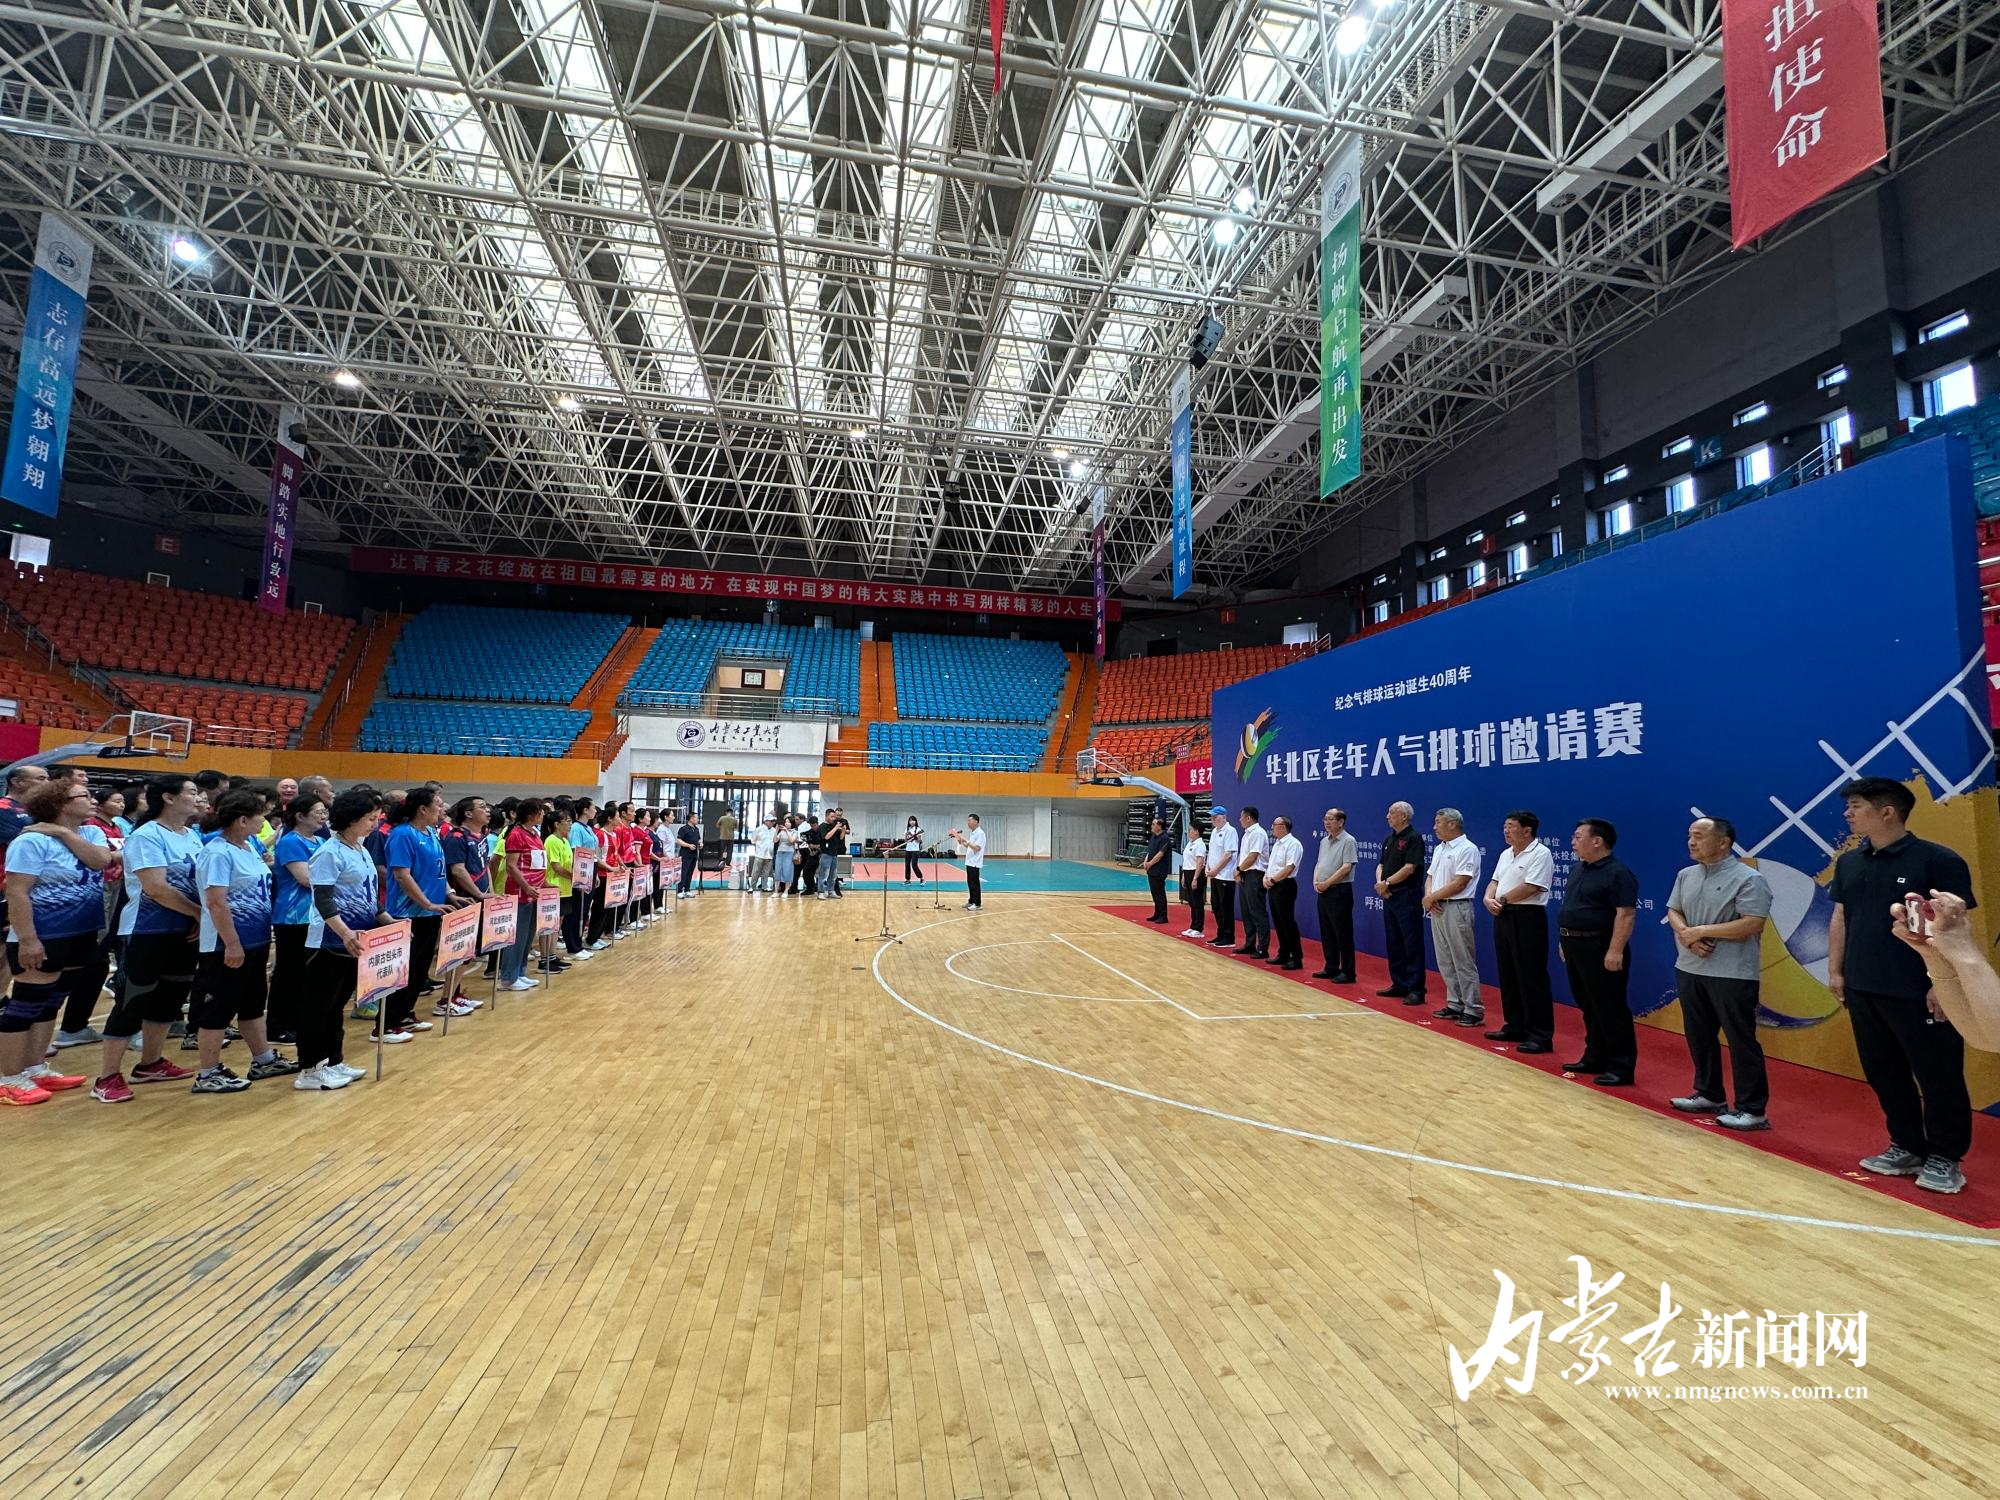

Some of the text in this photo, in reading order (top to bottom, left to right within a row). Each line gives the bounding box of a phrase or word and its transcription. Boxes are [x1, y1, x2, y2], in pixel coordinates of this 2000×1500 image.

[1330, 243, 1349, 466] 扬帆启航再出发
[22, 301, 69, 491] 志存高远梦翱翔
[266, 462, 294, 598] 脚踏实地行致远
[390, 553, 1093, 617] 让青春之花绽放在祖国最需要的地方 在实现中国梦的伟大实践中书写别样精彩的人生
[1334, 665, 1472, 711] 纪念气排球运动诞生40周年
[1265, 701, 1645, 785] 华北区老年人气排球邀请赛
[368, 947, 402, 968] 内蒙古包头市
[377, 964, 393, 980] 代表队
